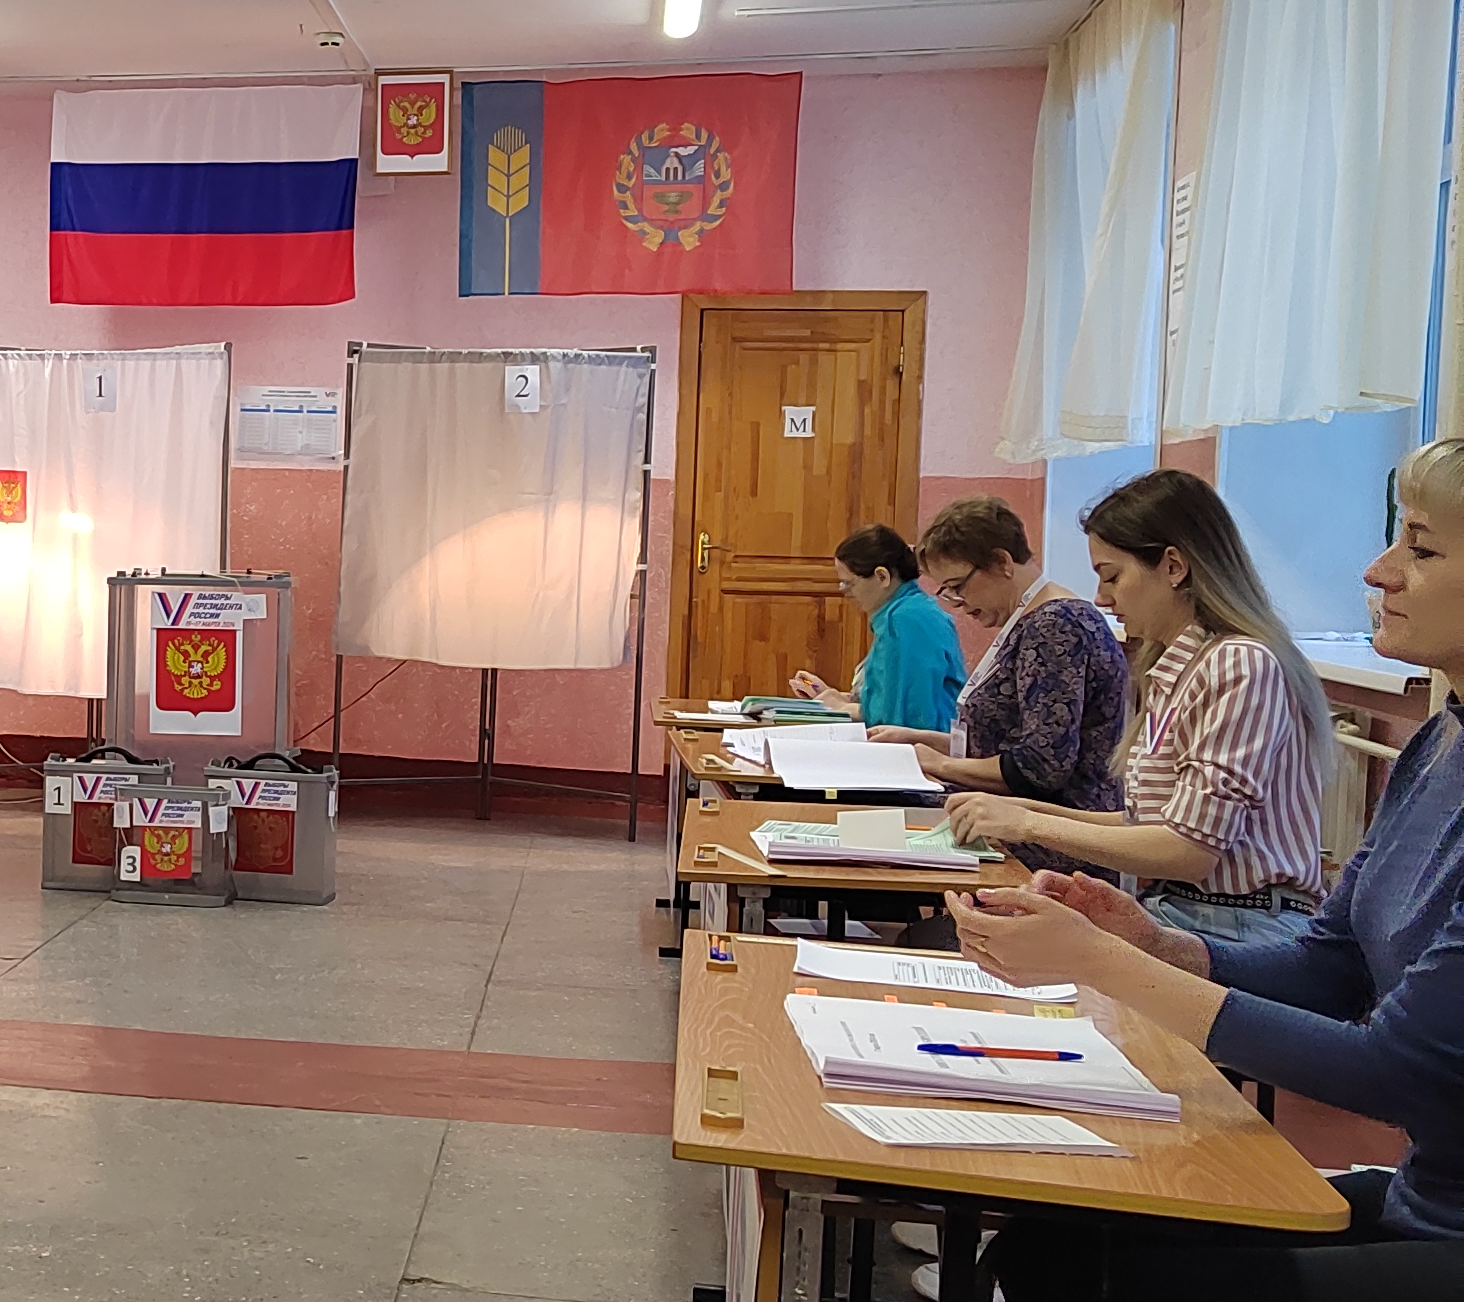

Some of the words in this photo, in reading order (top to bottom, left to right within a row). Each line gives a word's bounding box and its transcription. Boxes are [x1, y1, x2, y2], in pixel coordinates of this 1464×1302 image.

[95, 374, 106, 398] 1
[514, 374, 531, 398] 2
[789, 417, 808, 433] М
[196, 593, 233, 601] ВЫБОРЫ
[192, 602, 243, 611] ПРЕЗИДЕНТА
[188, 611, 222, 620] РОССИИ
[52, 786, 65, 806] 1
[124, 855, 137, 874] 3
